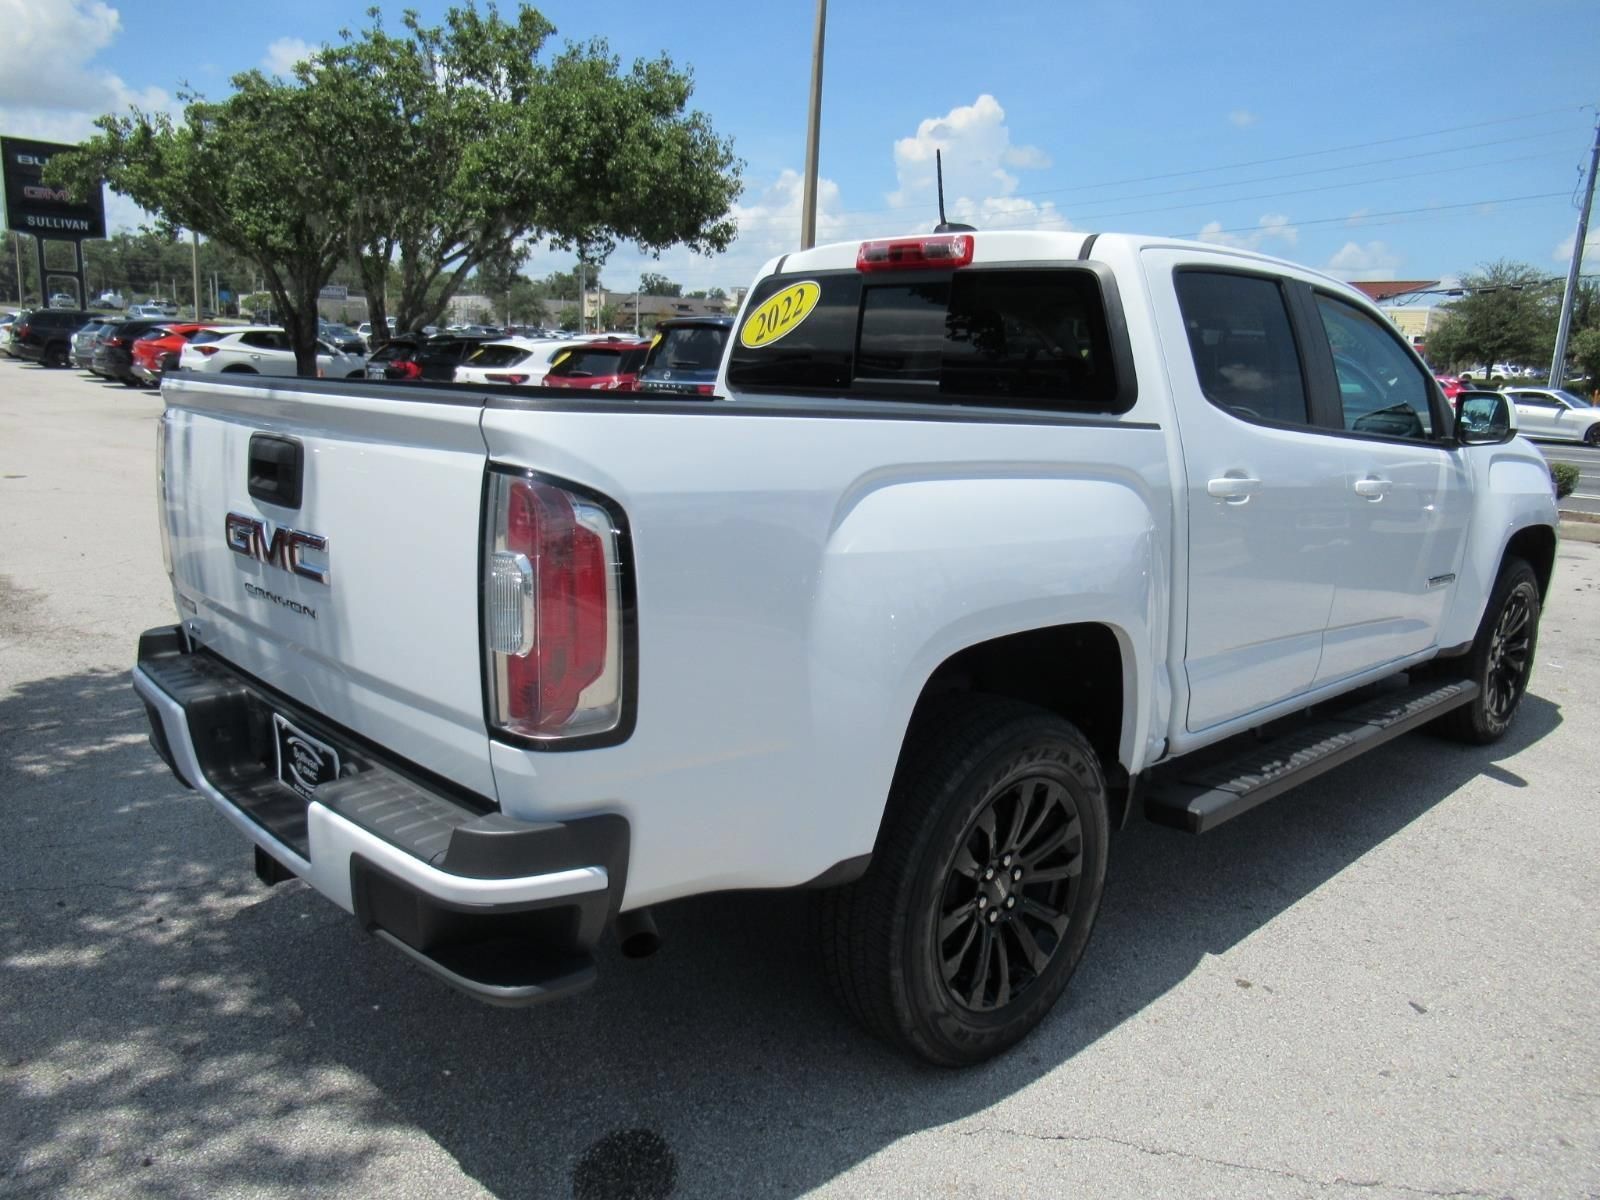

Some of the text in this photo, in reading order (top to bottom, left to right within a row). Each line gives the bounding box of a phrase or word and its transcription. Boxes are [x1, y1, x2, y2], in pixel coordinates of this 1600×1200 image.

[24, 186, 71, 200] GM
[27, 215, 88, 230] SULLIVAN
[755, 287, 805, 343] 2022
[225, 511, 331, 588] GMC
[244, 582, 318, 620] CANYON
